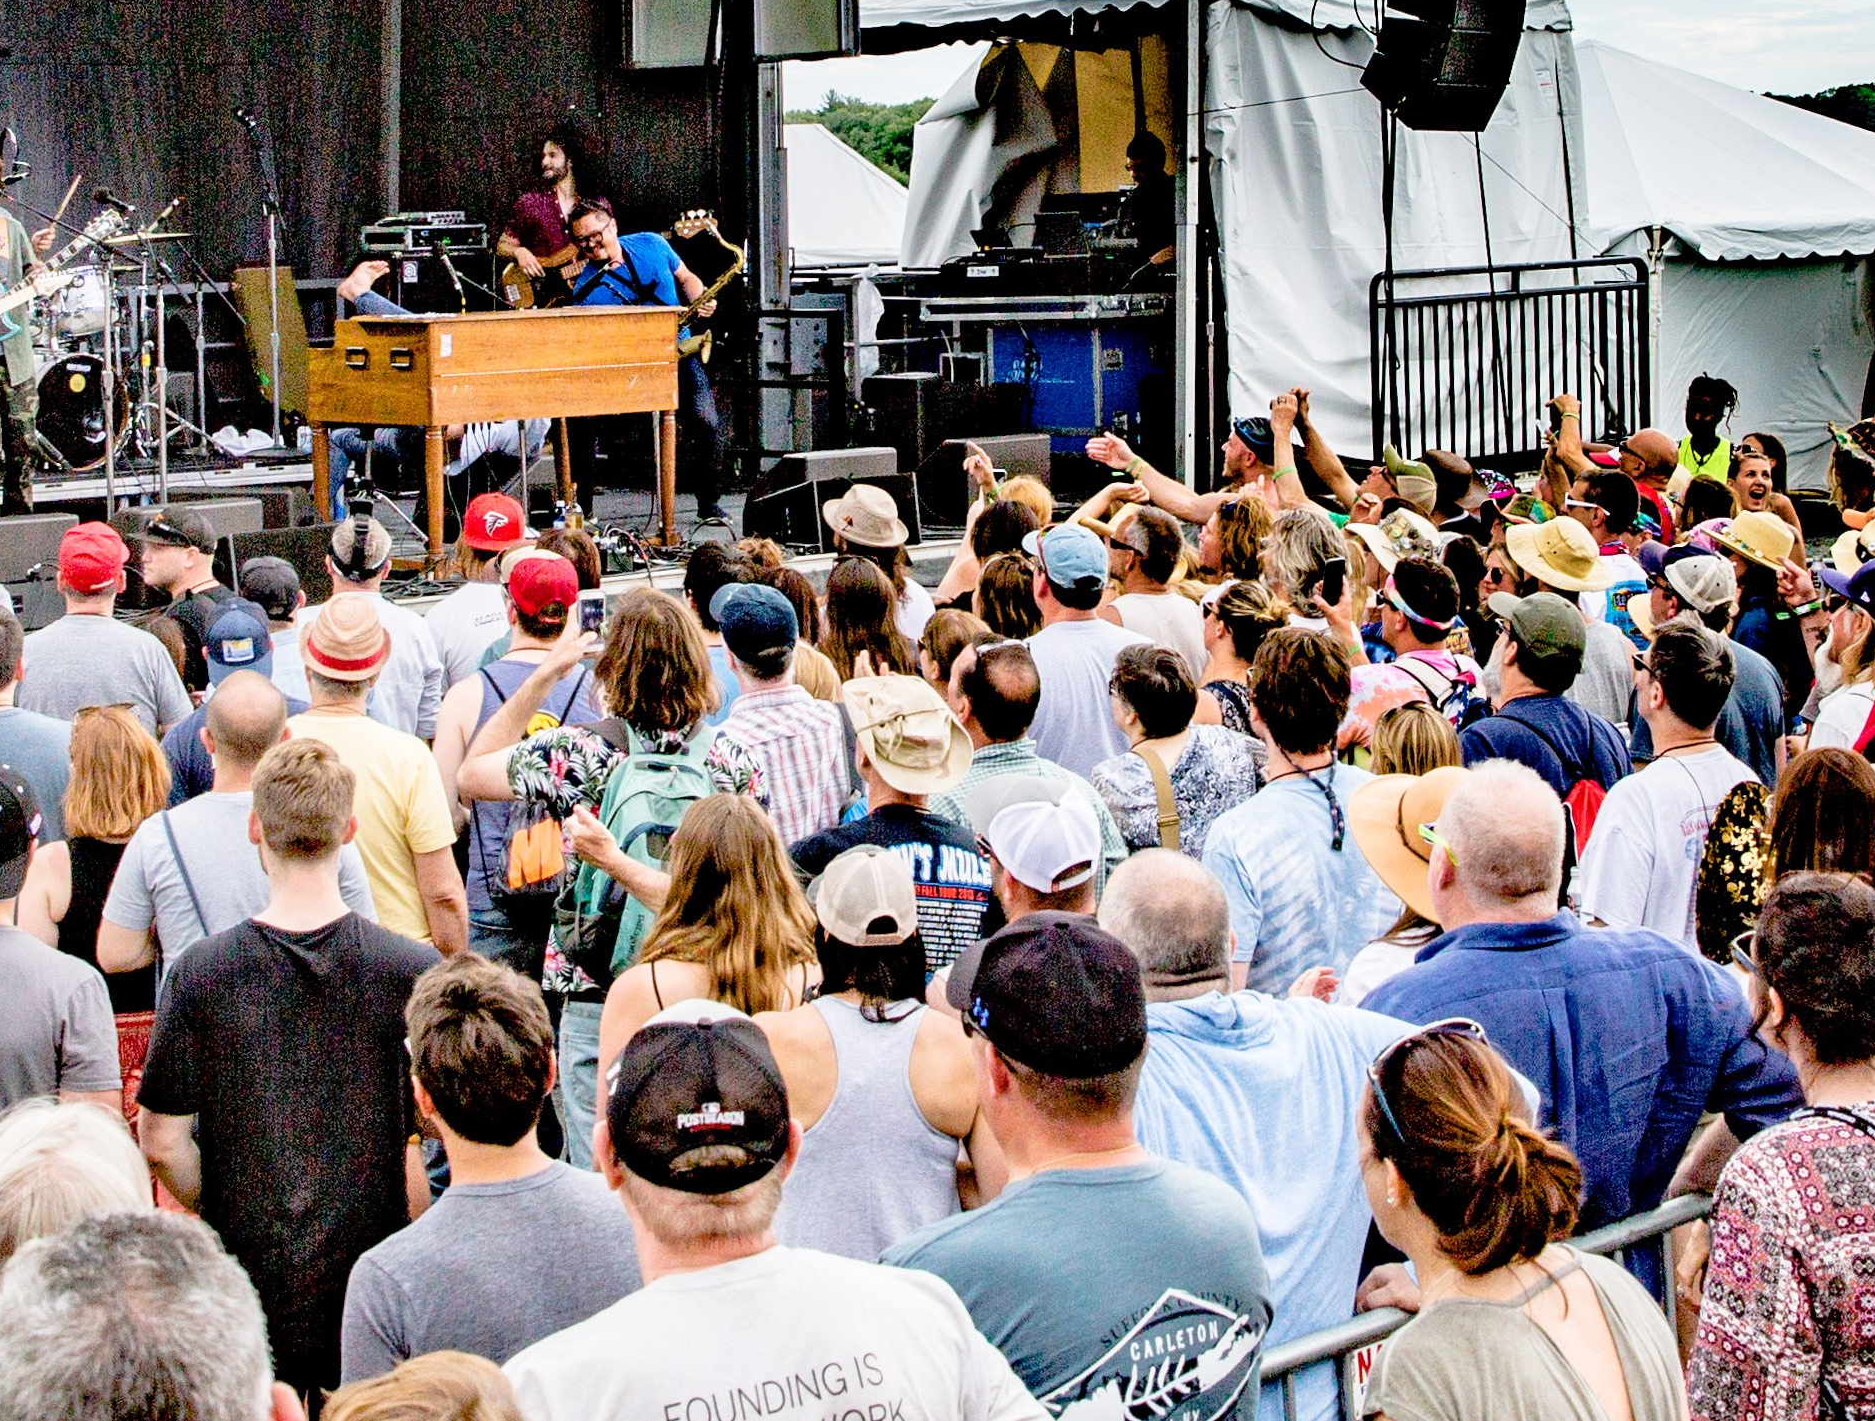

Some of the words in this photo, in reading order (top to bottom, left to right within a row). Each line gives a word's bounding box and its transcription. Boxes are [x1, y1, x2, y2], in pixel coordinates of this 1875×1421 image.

[676, 1110, 745, 1129] POSTSEASON
[1130, 1320, 1219, 1362] CARLETON
[663, 1362, 849, 1421] FOUNDING
[853, 1352, 884, 1390] IS
